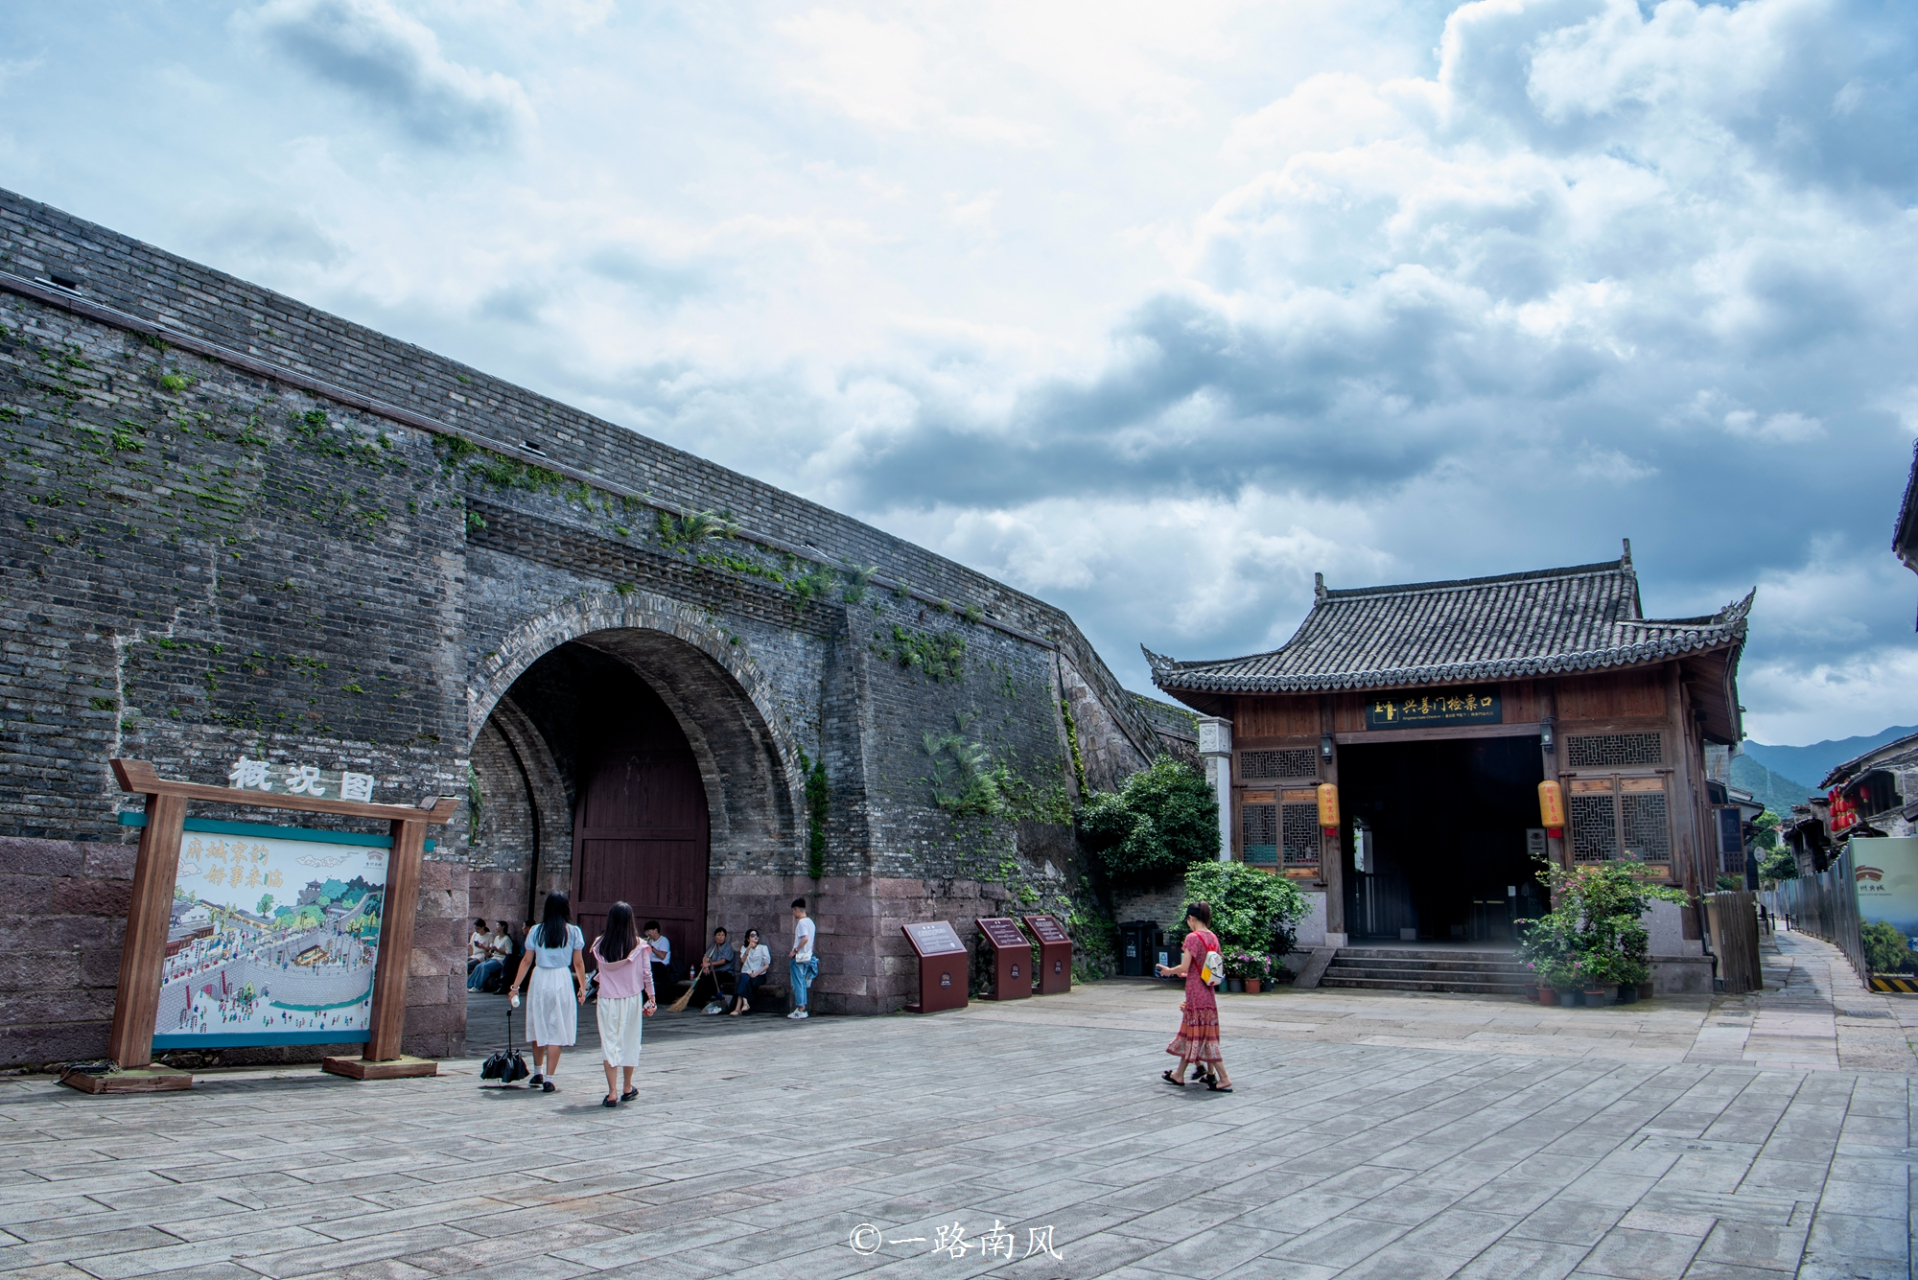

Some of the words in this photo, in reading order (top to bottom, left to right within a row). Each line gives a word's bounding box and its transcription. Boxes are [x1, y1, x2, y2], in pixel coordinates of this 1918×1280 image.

[1402, 693, 1493, 715] 兴善门检票口
[229, 755, 374, 803] 概况图
[185, 837, 269, 866] 府城宋韵
[203, 864, 284, 889] 好事来临
